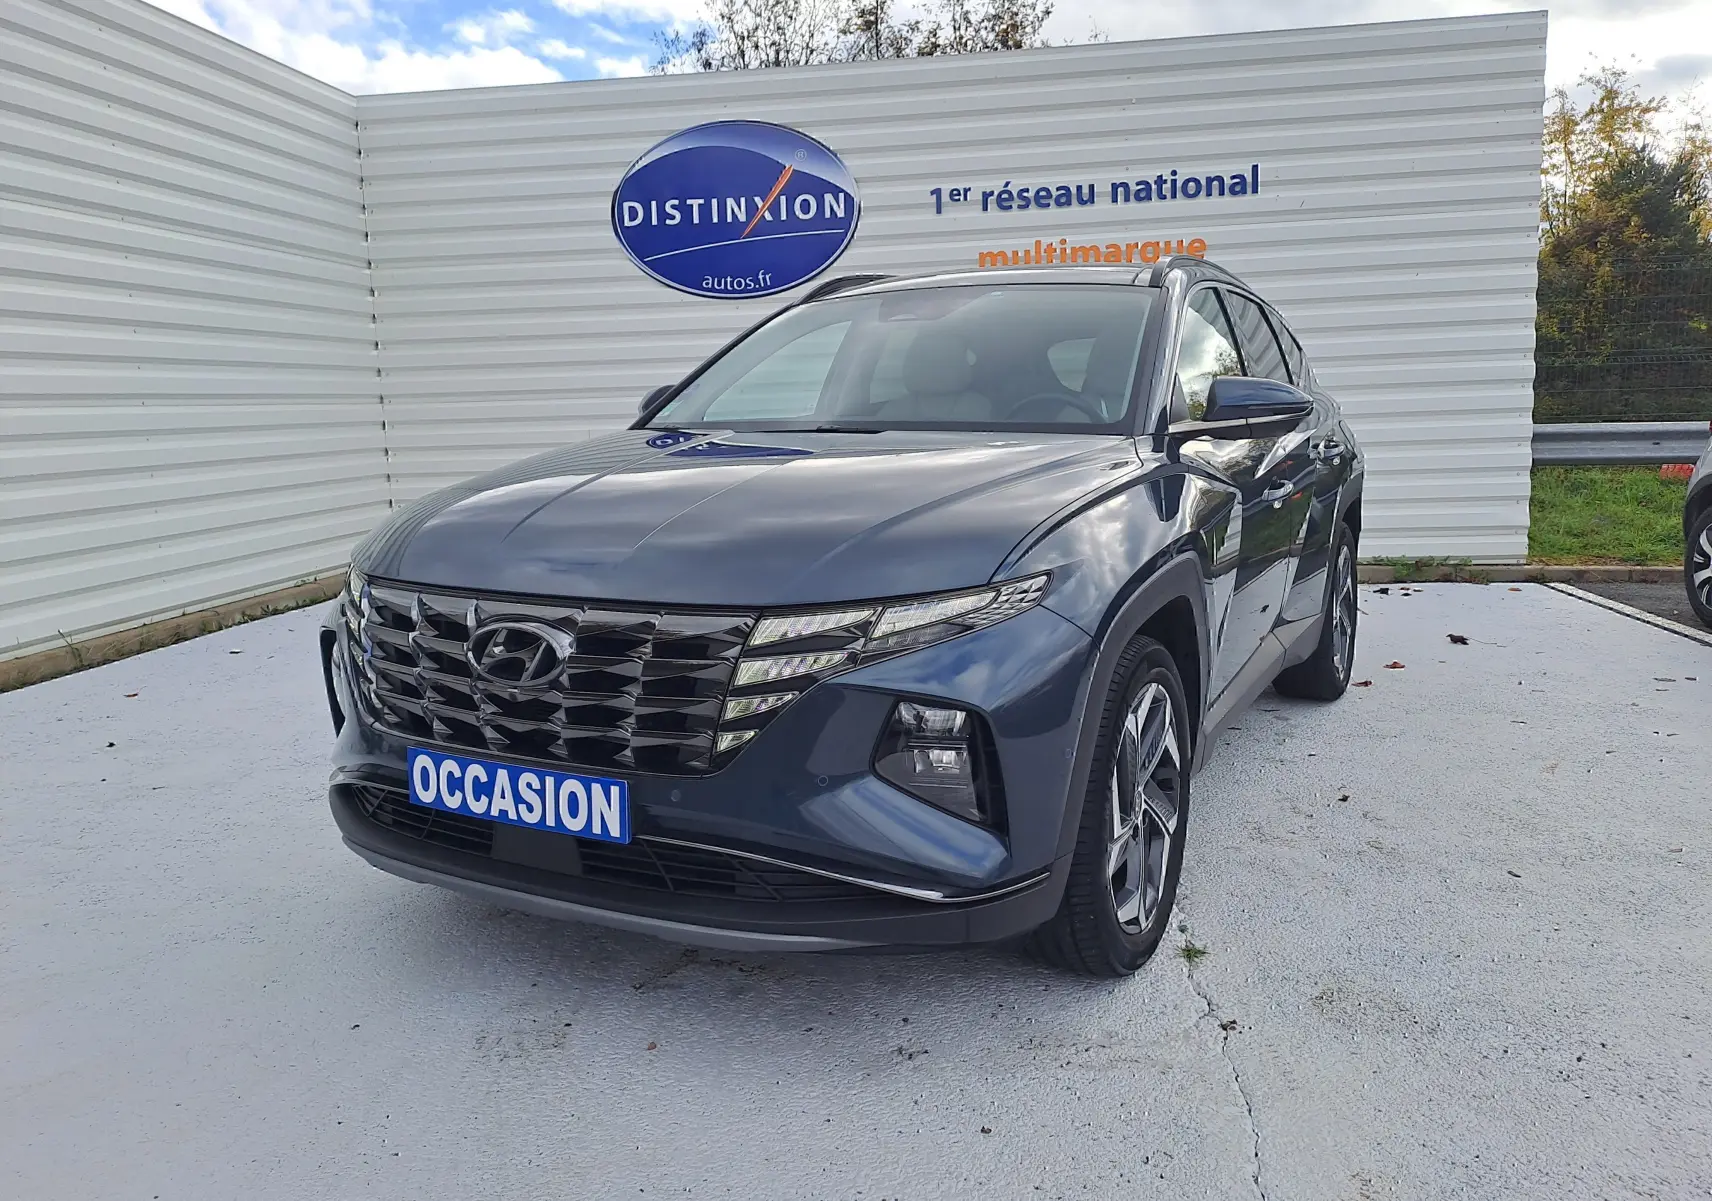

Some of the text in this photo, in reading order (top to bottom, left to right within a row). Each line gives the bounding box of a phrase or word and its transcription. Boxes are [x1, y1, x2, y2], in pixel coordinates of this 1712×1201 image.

[622, 191, 847, 228] DISTINXION
[929, 163, 1259, 215] 1er réseau national
[702, 269, 773, 291] autos.fr
[412, 753, 621, 838] OCCASION
